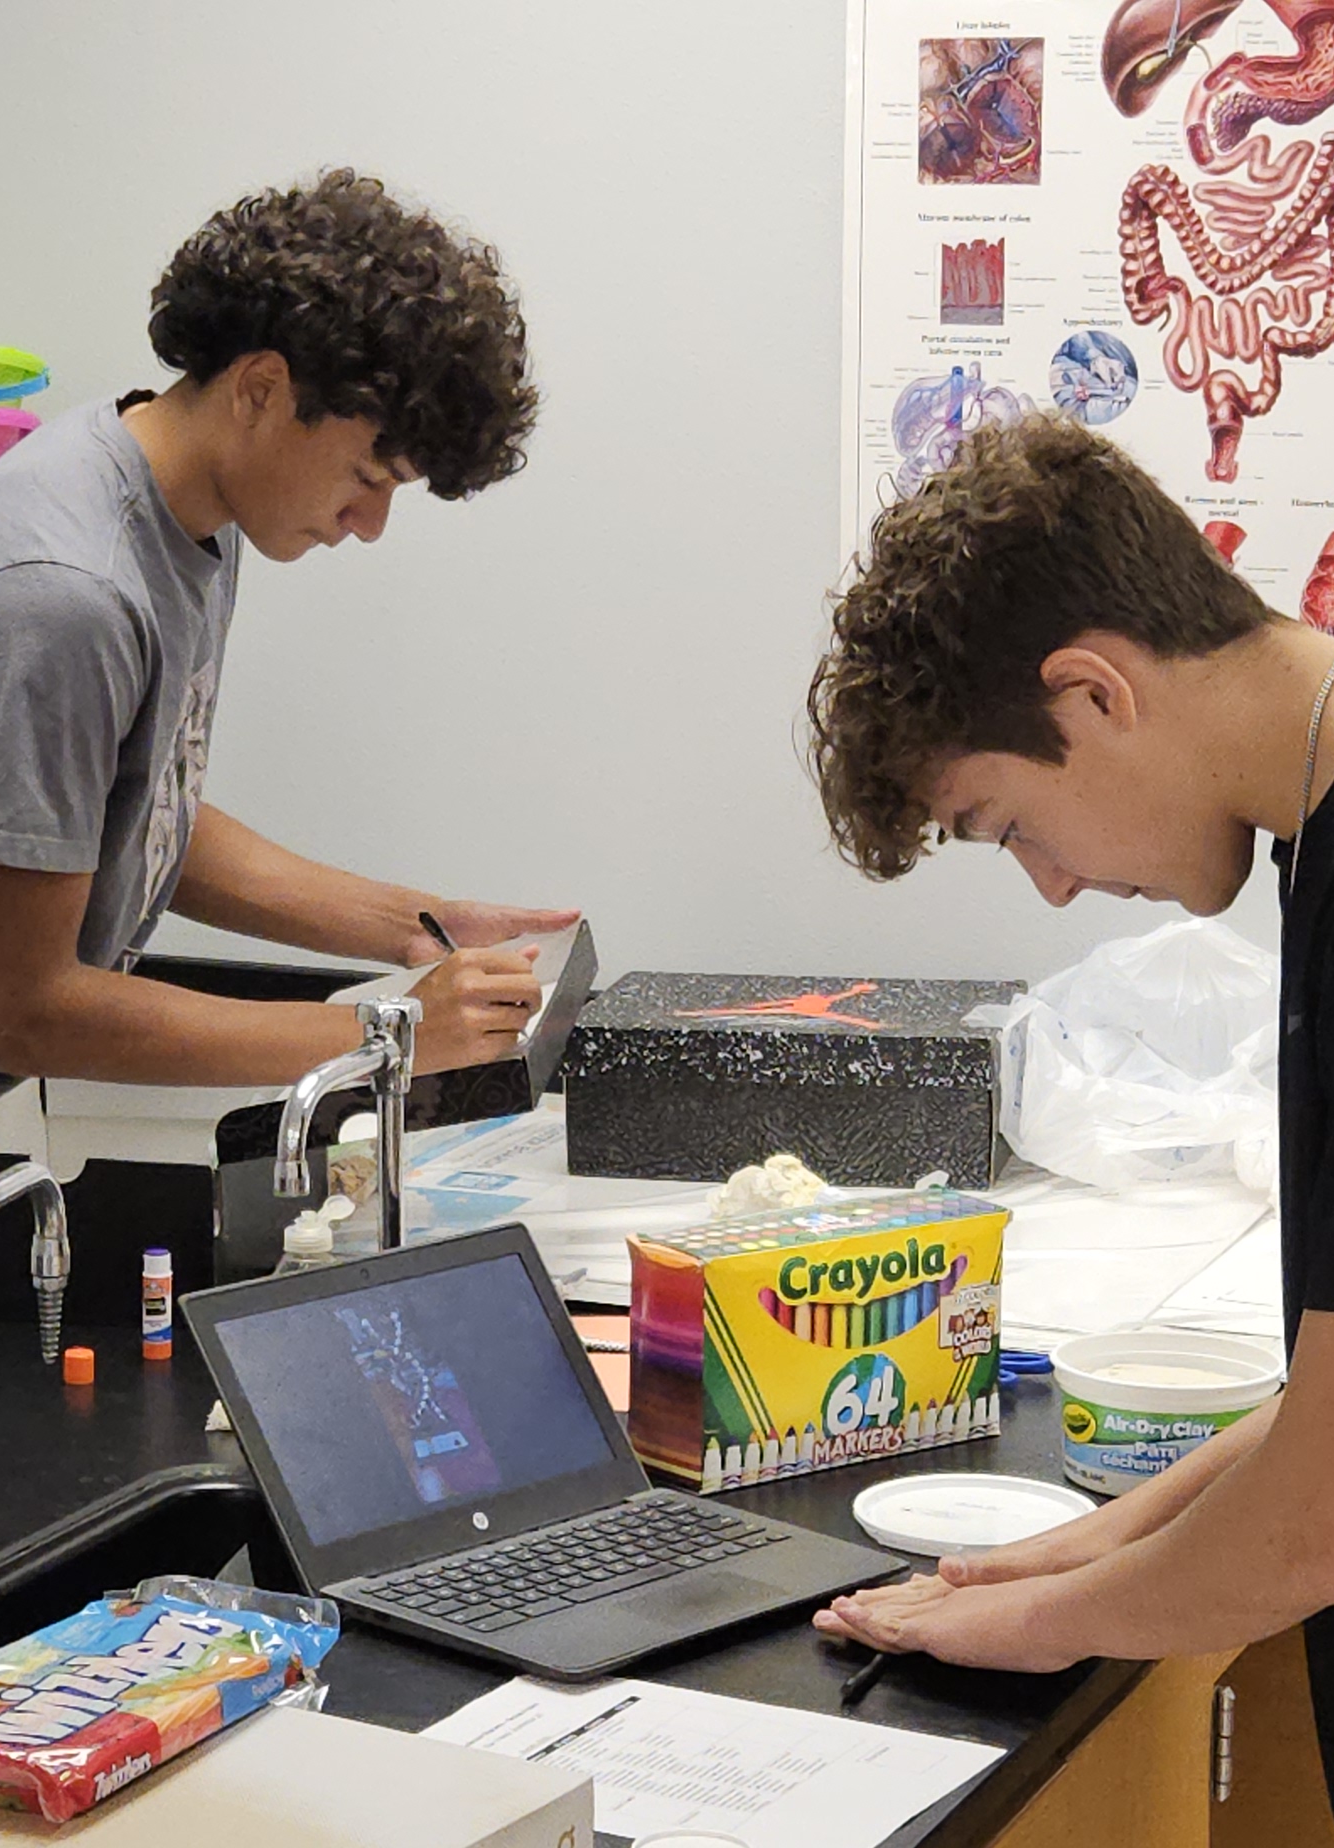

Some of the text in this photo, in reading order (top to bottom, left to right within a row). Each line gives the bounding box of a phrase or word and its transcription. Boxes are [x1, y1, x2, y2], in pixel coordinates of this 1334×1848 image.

[779, 1237, 946, 1300] Crayola
[826, 1365, 899, 1437] 64
[1103, 1414, 1171, 1440] Air-Dry
[1172, 1421, 1215, 1439] Clay
[814, 1424, 905, 1465] MARKERS
